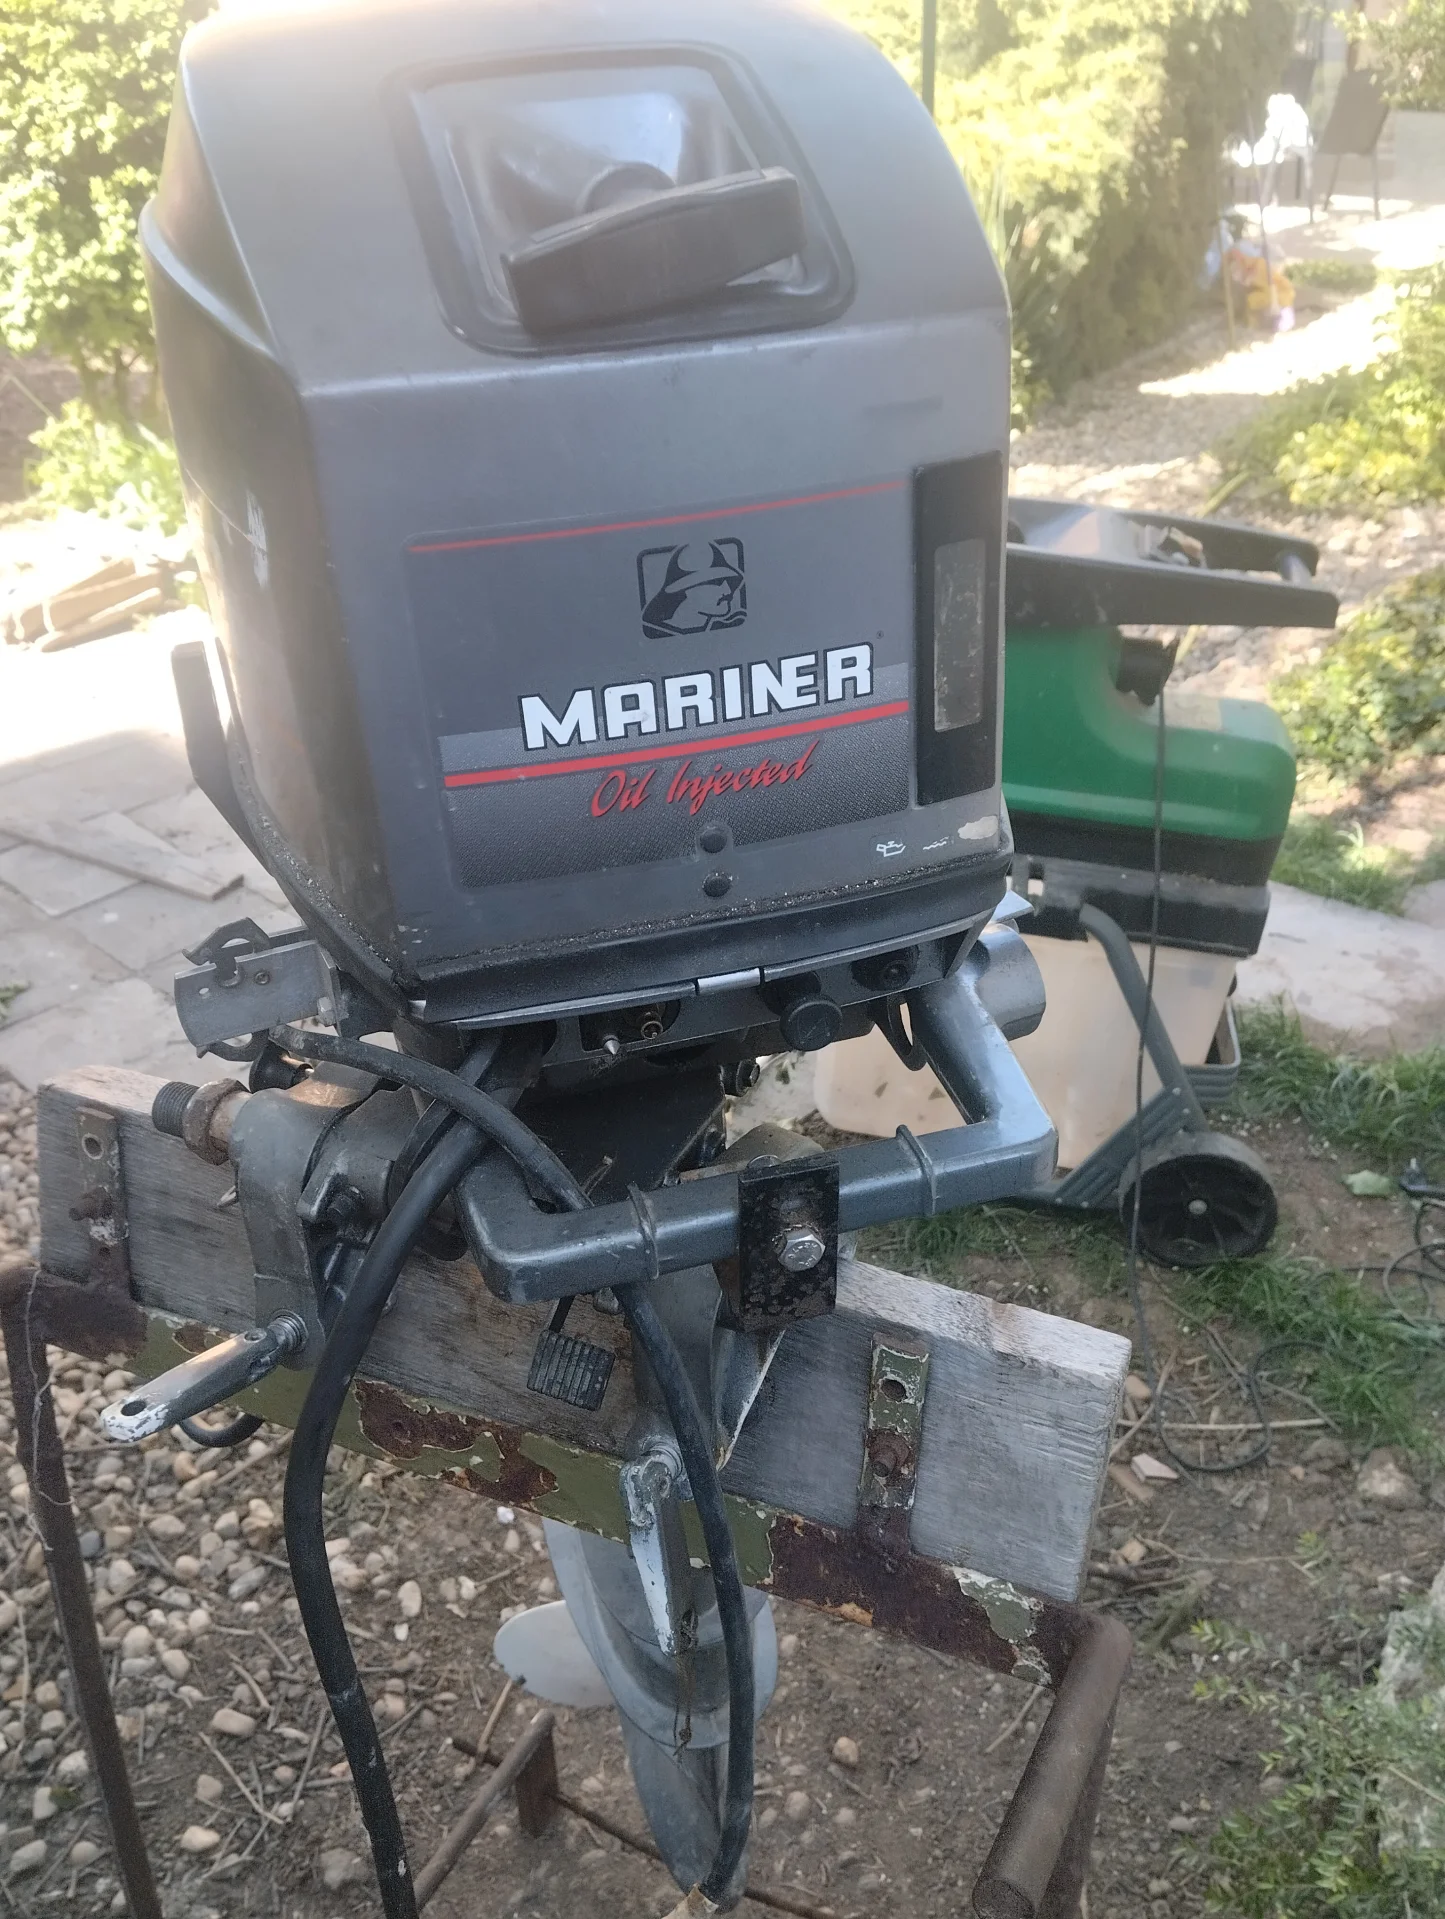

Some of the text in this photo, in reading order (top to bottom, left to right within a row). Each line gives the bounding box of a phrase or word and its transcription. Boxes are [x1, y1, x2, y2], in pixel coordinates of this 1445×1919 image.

[518, 641, 874, 750] MARINER
[591, 739, 819, 817] Oil Injected
